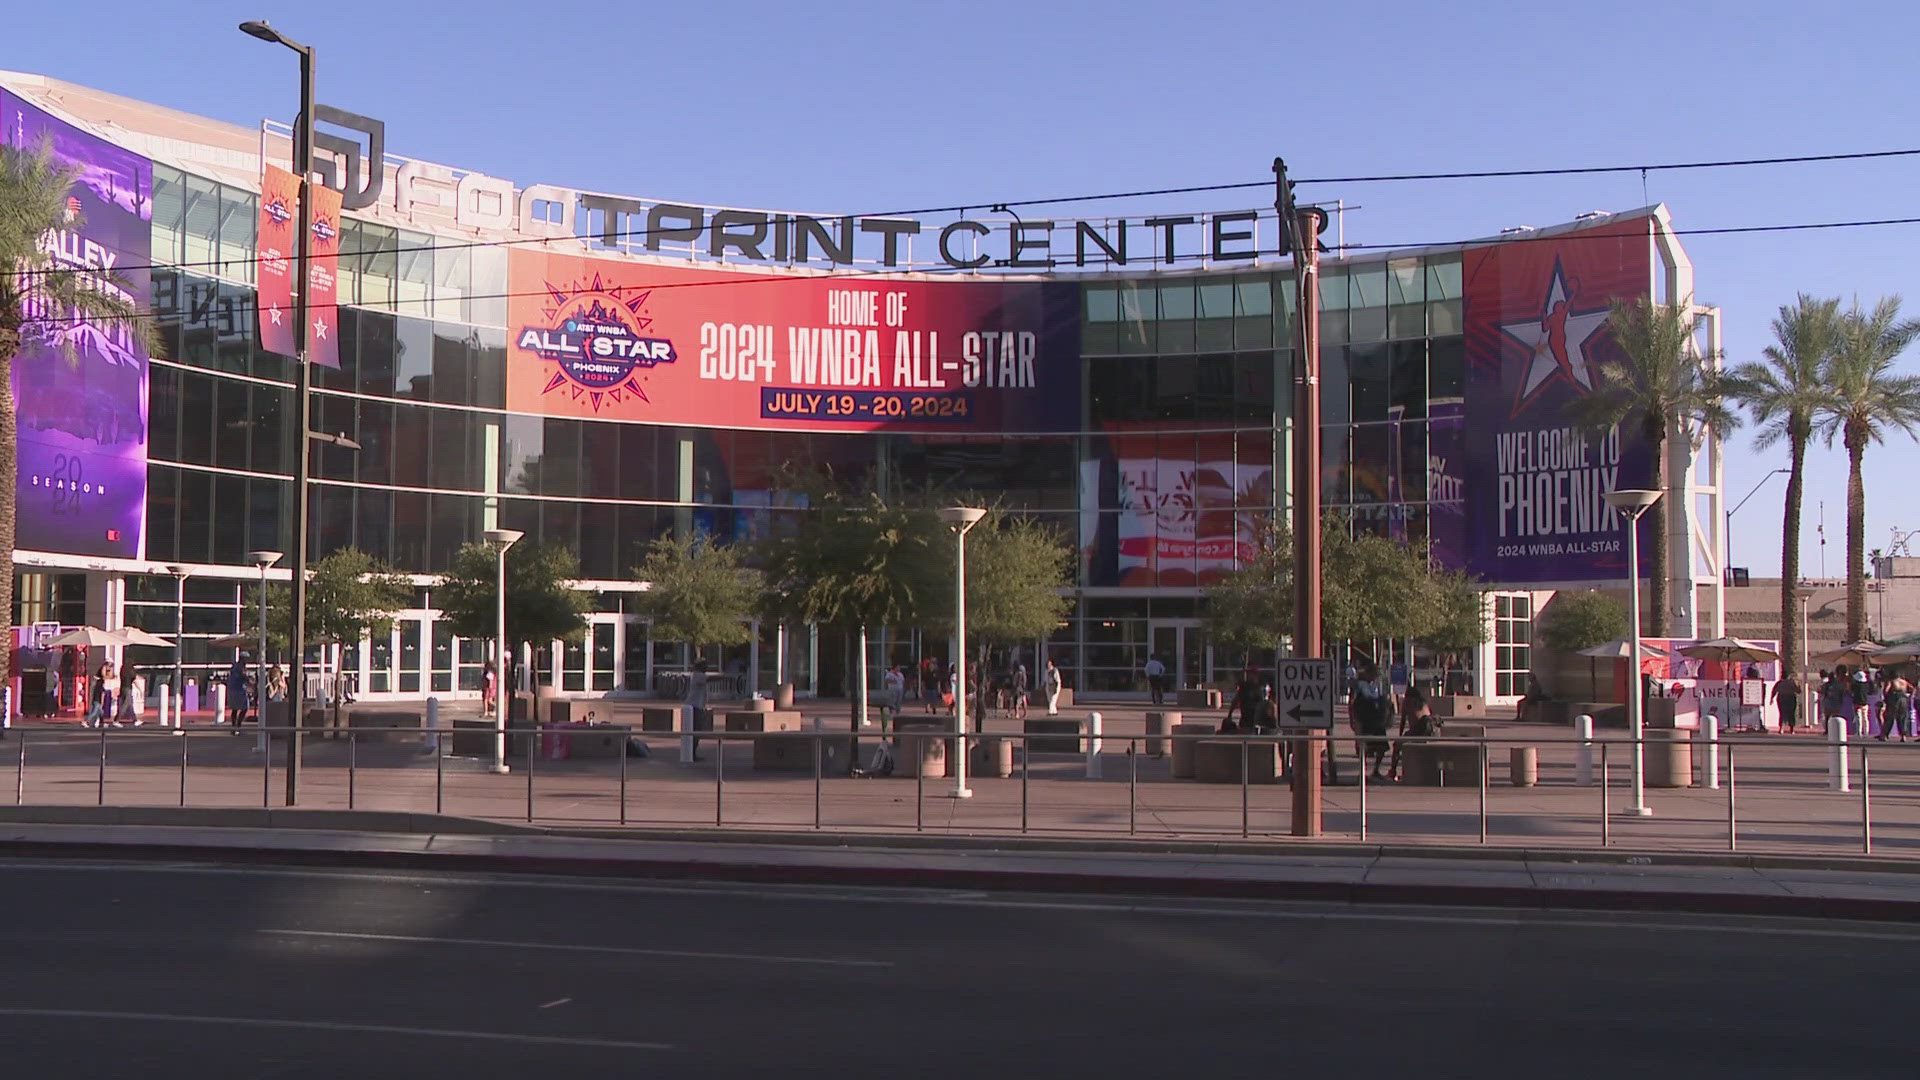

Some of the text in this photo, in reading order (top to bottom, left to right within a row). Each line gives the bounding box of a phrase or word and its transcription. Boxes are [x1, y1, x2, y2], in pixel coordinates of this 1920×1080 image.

[396, 161, 1329, 268] FOOTPRINT CENTER
[828, 289, 908, 327] HOME OF
[577, 324, 627, 336] AT&T WNBA
[520, 330, 671, 361] ALL STAR
[700, 321, 1036, 389] 2024 WNBA ALL-STAR
[573, 362, 620, 374] PHOENIX
[768, 392, 820, 415] JULY
[826, 394, 855, 415] 19
[872, 396, 907, 419] 20,
[910, 397, 968, 418] 2024
[1496, 427, 1590, 474] WELCOME
[32, 475, 105, 495] SEASON
[1498, 466, 1620, 537] PHOENIX
[1497, 540, 1620, 557] 2024 WNBA ALL-STAR
[1284, 664, 1326, 680] ONE
[1283, 685, 1327, 701] WAY
